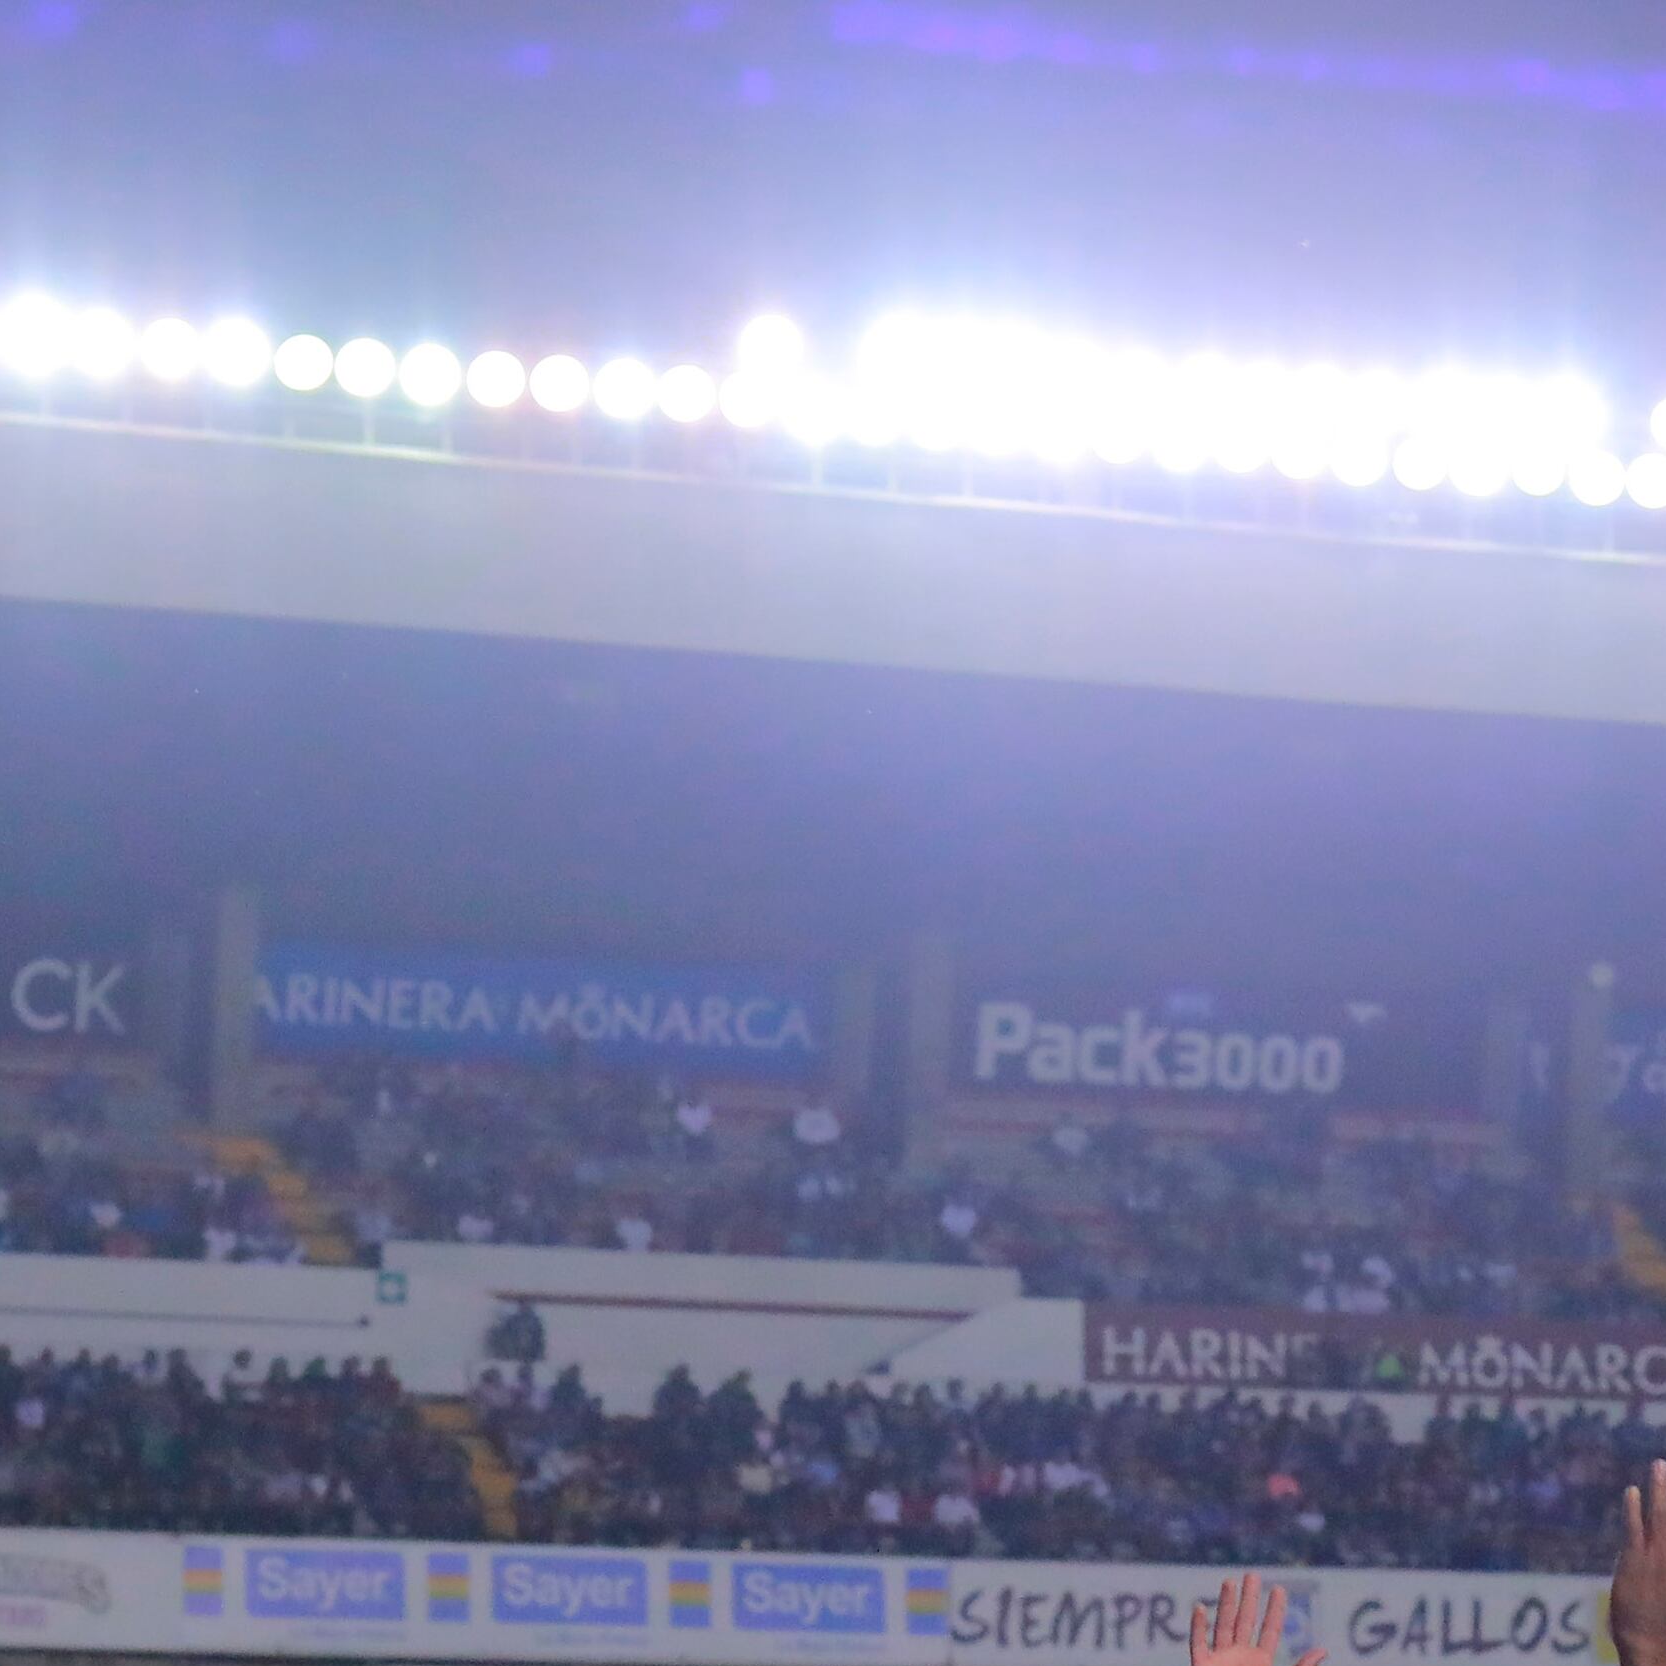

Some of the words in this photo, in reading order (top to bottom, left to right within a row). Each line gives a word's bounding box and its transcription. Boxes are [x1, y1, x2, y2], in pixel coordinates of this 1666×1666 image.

[974, 1002, 1341, 1095] Pack3000
[255, 1555, 390, 1604] Sayer
[501, 1564, 632, 1616] Sayer
[742, 1570, 874, 1626] Sayer
[1348, 1597, 1592, 1656] GALLOS
